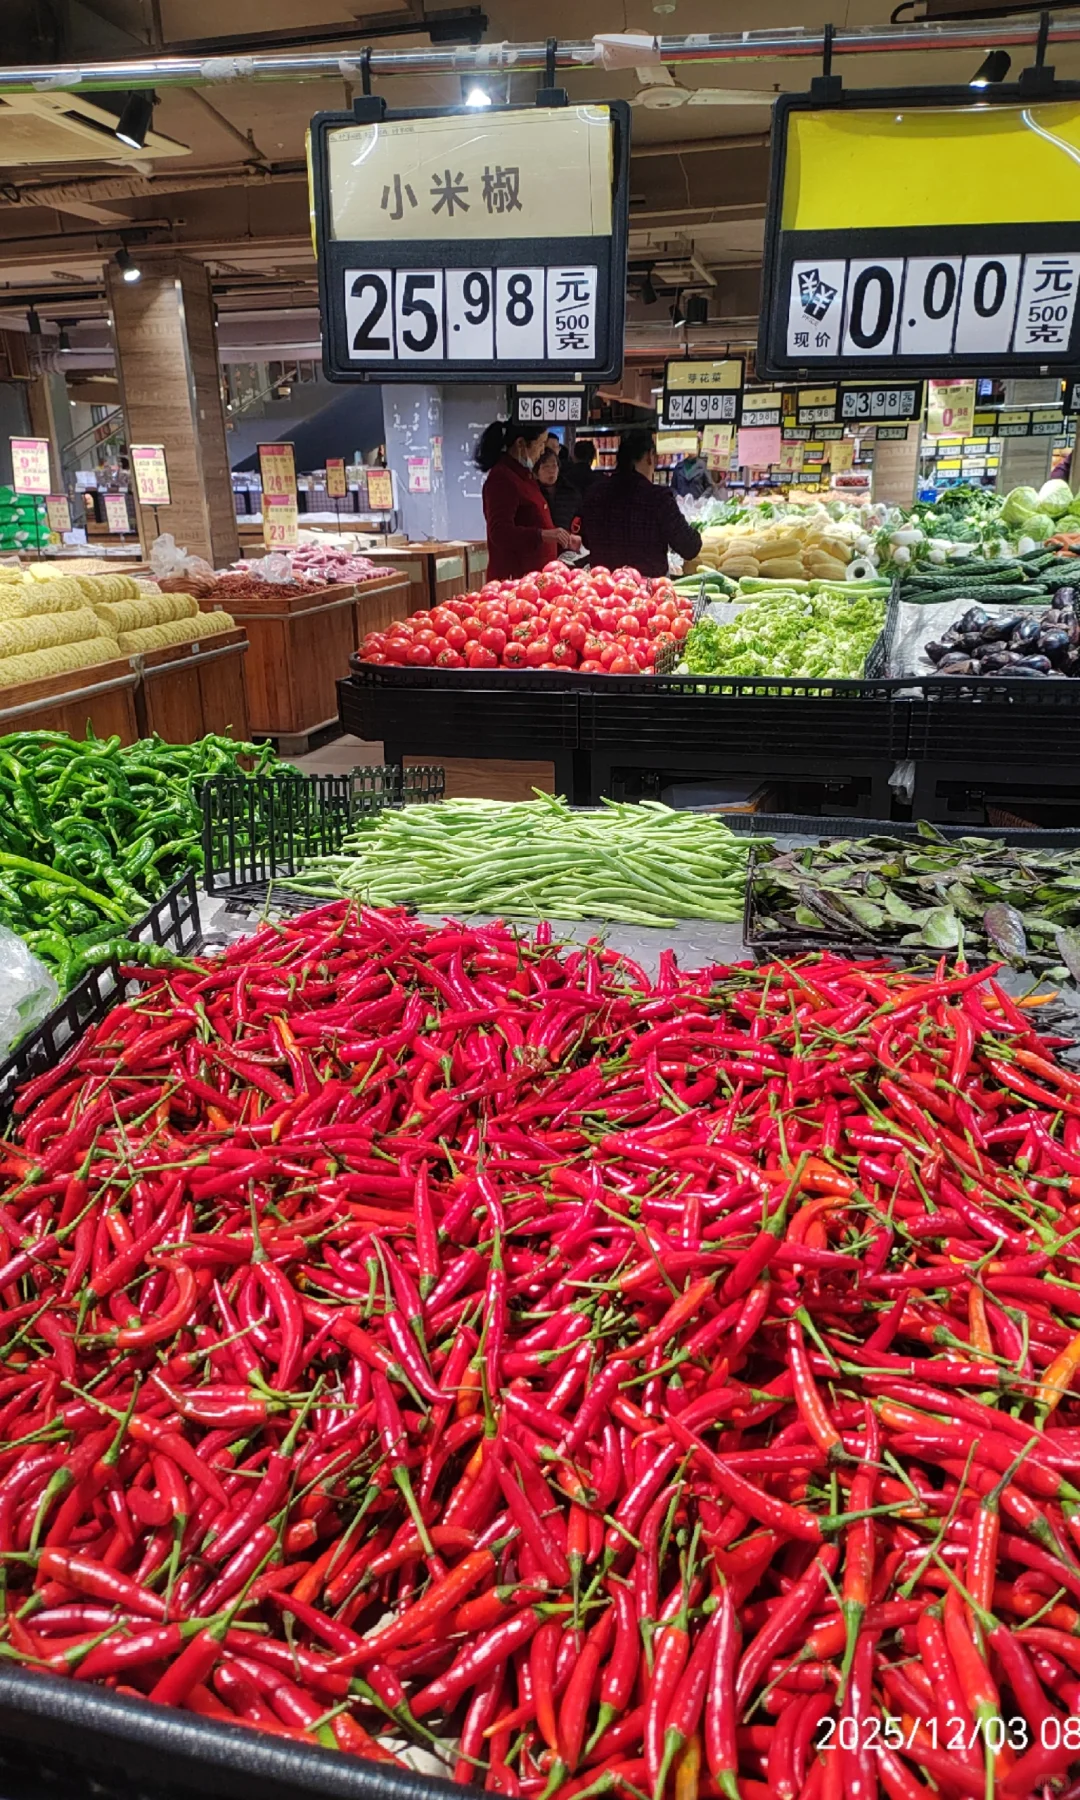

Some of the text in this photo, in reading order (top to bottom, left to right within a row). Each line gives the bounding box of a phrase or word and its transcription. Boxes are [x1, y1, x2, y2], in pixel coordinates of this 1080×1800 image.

[380, 166, 523, 220] 小米椒
[350, 271, 534, 352] 25.98
[849, 261, 1007, 349] 0.00
[793, 331, 832, 348] 现价
[687, 372, 722, 384] 芽花菜
[533, 398, 566, 418] 6.98
[683, 396, 719, 417] 4.98
[858, 392, 898, 413] 3.98
